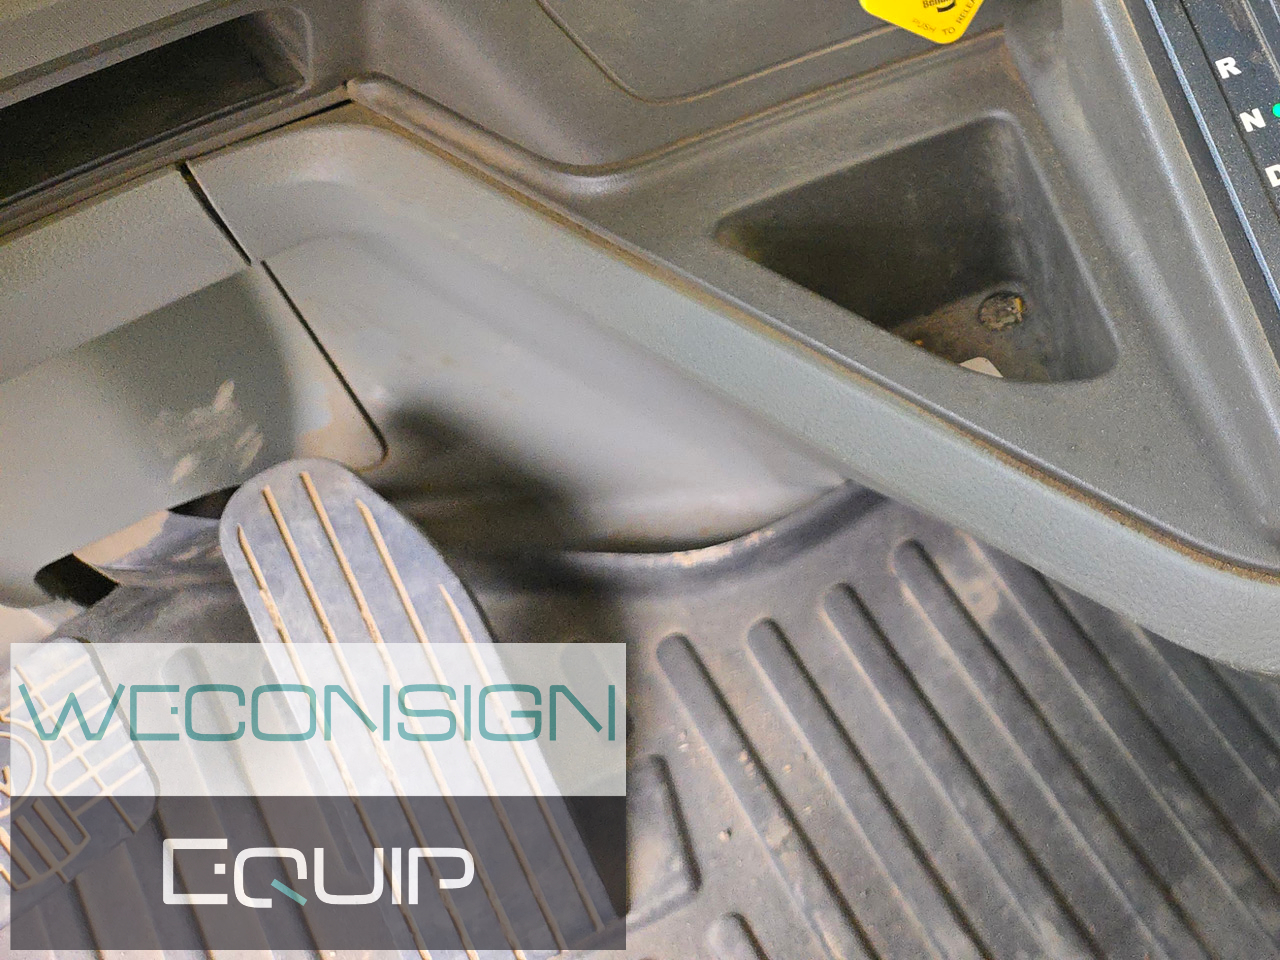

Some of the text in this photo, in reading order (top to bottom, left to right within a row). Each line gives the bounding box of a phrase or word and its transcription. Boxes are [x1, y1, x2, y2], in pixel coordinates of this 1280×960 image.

[942, 26, 956, 36] TO
[1214, 56, 1242, 79] R
[1239, 108, 1266, 132] N
